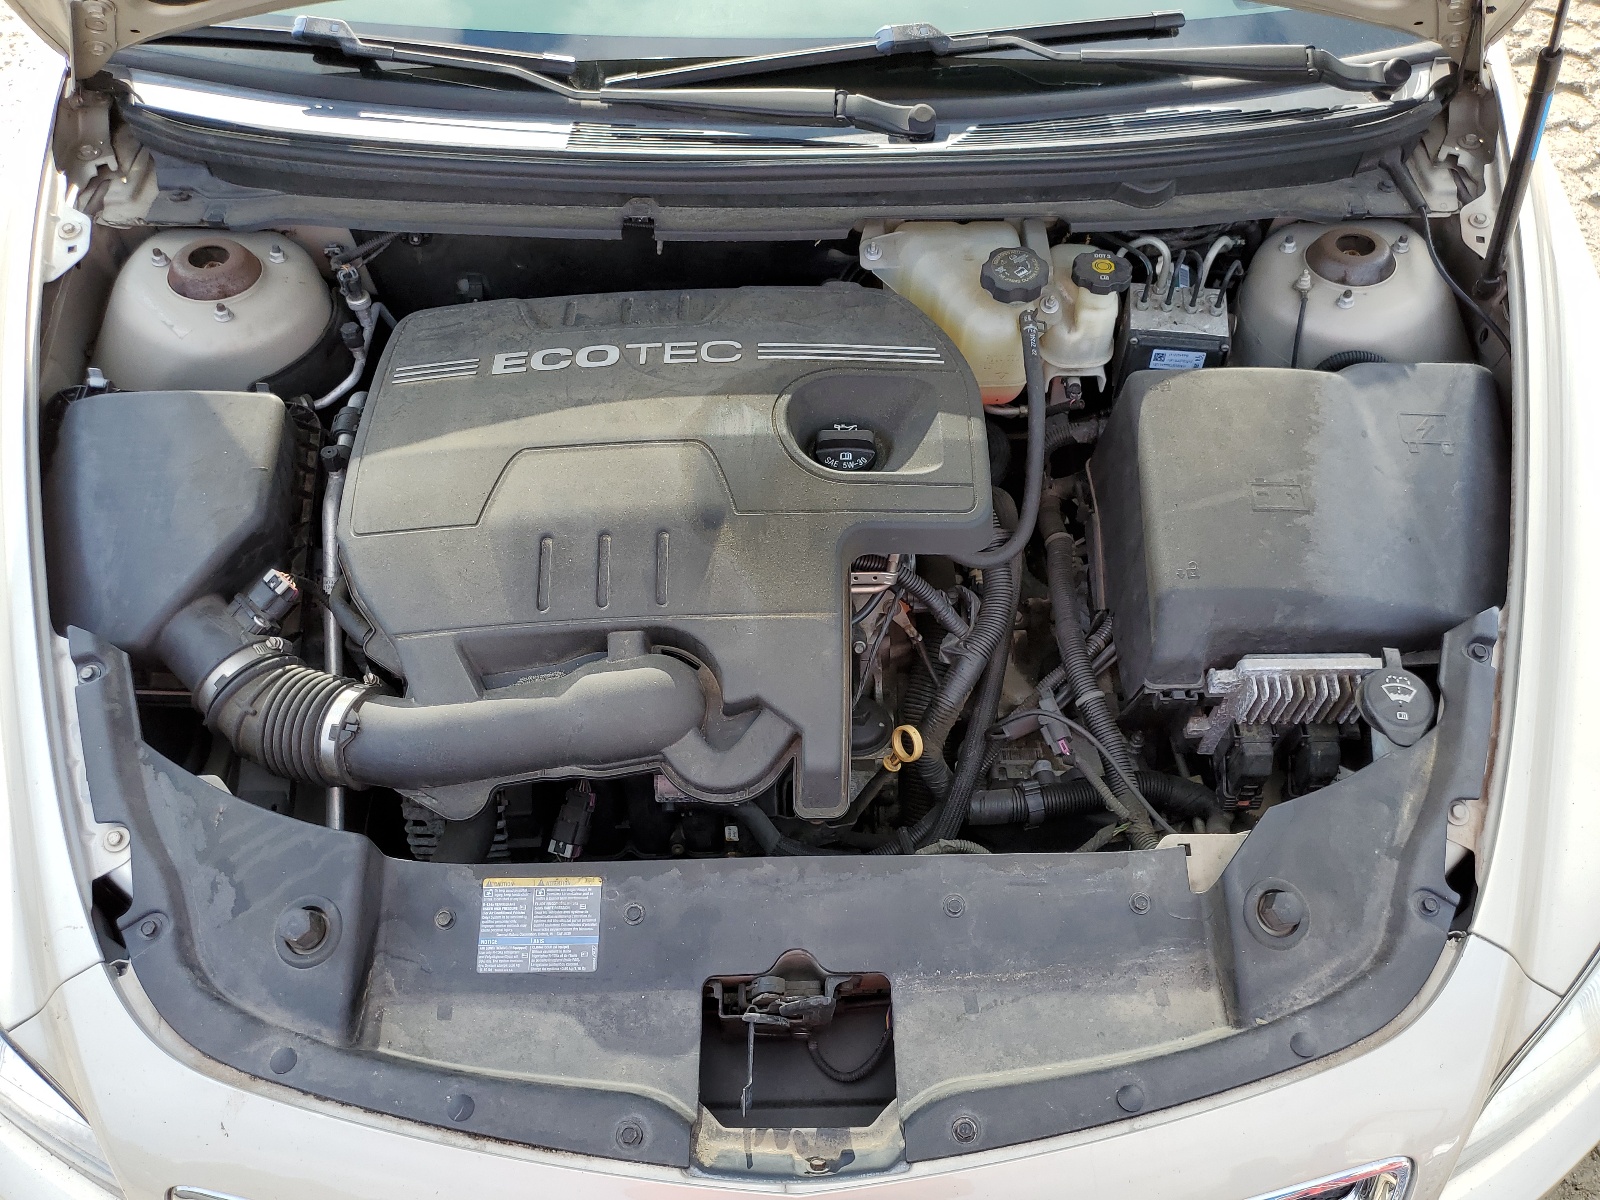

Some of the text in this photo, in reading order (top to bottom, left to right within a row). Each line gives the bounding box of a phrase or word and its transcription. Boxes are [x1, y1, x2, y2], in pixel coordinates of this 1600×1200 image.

[491, 339, 743, 376] ECOTEC
[824, 456, 868, 469] SAE 5W-30
